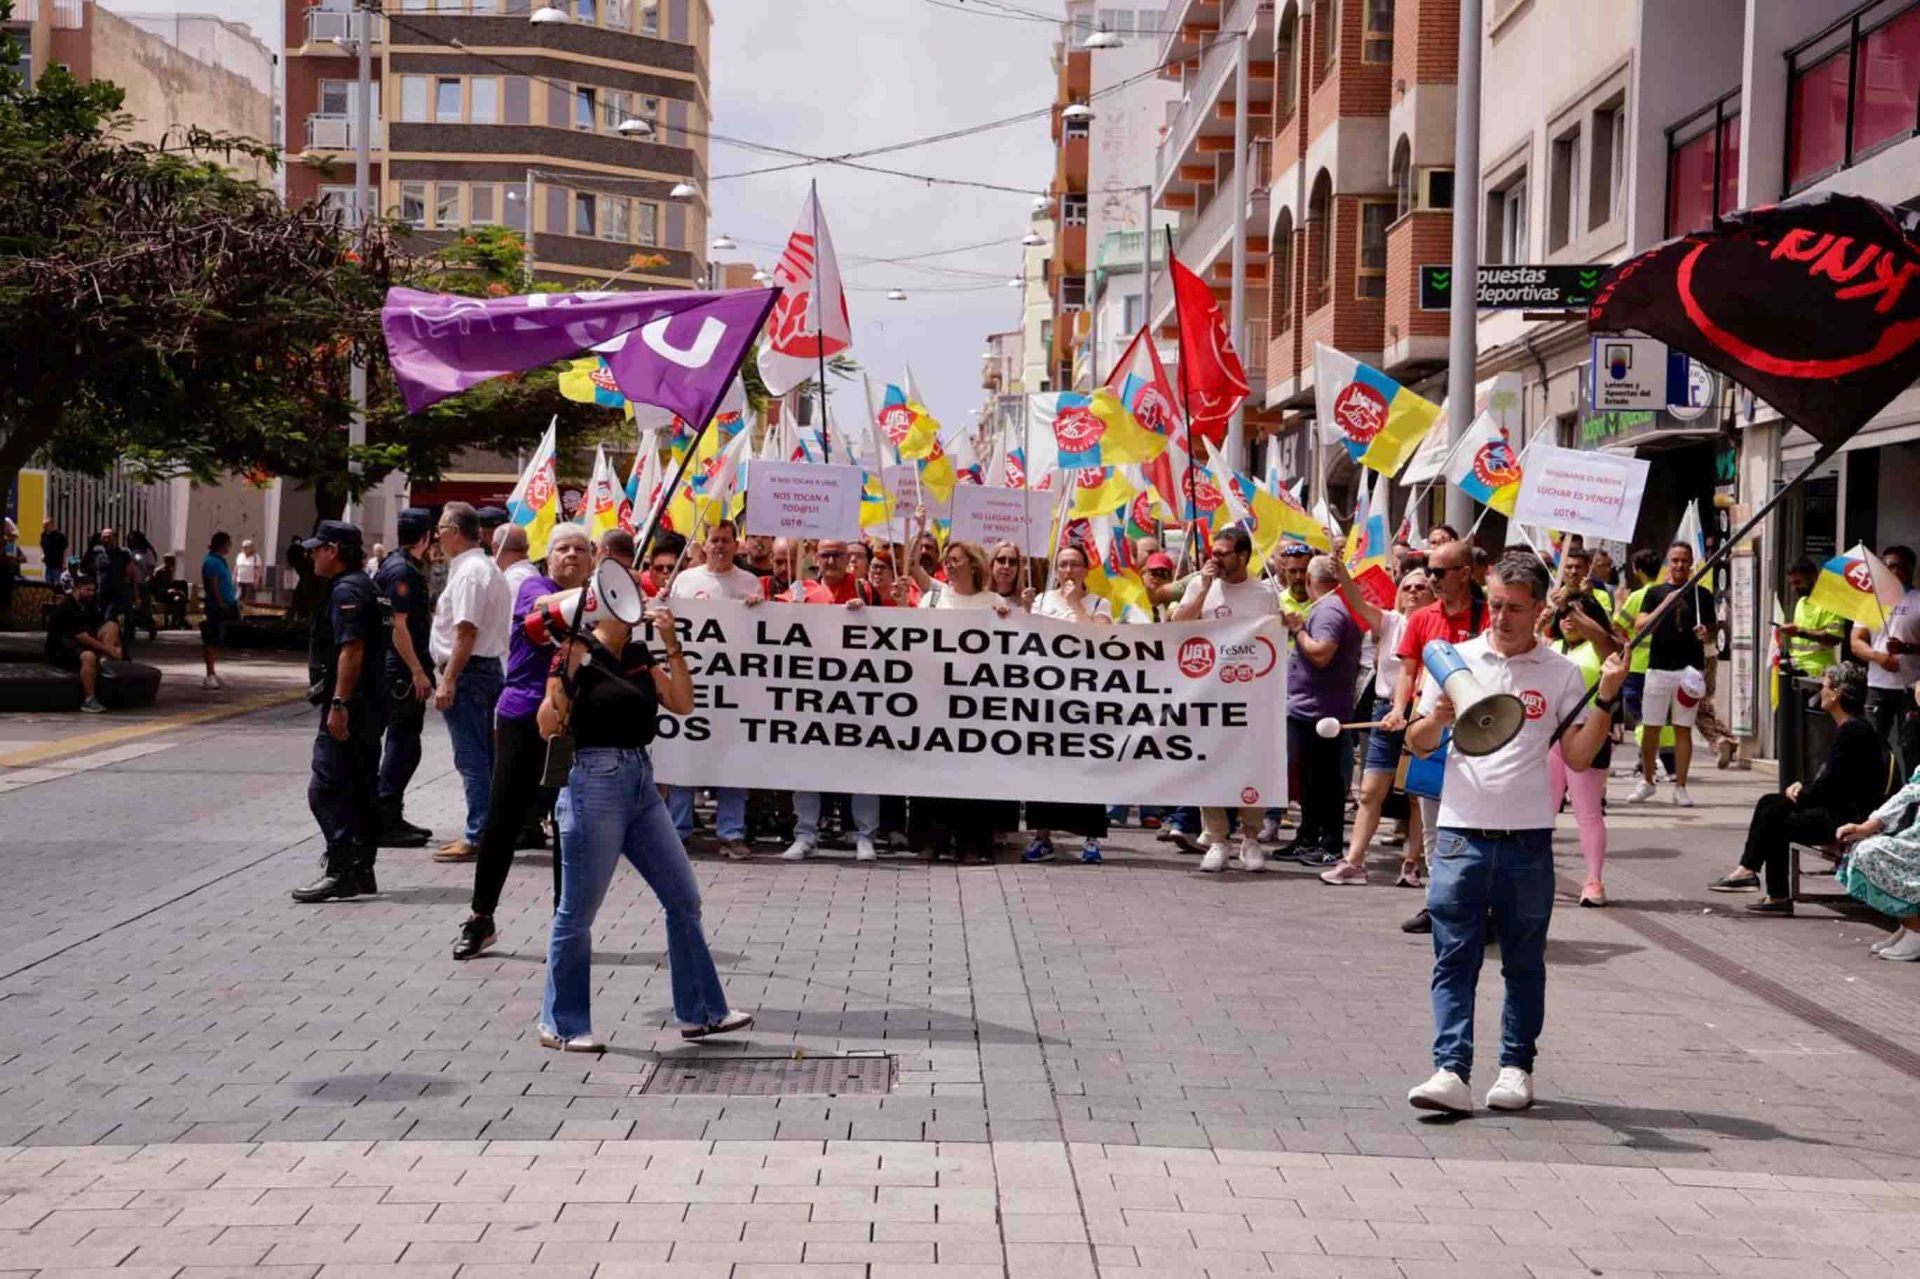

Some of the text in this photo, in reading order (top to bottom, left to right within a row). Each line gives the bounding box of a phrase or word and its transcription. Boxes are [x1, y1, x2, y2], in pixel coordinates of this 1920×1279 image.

[1477, 267, 1547, 284] puestas
[1477, 285, 1560, 306] deportivas
[1604, 397, 1629, 405] Estado
[1605, 389, 1638, 397] Apuestas
[773, 492, 790, 501] NOS
[794, 493, 821, 502] TOCAN
[1537, 486, 1571, 498] LUCHAR
[756, 620, 812, 648] LA
[842, 624, 1165, 662] EXPLOTACIÓN
[943, 662, 1173, 695] LABORAL.
[693, 684, 1248, 727] EL TRATO DENIGRANTE
[656, 713, 1206, 762] OS TRABAJADORES/AS.
